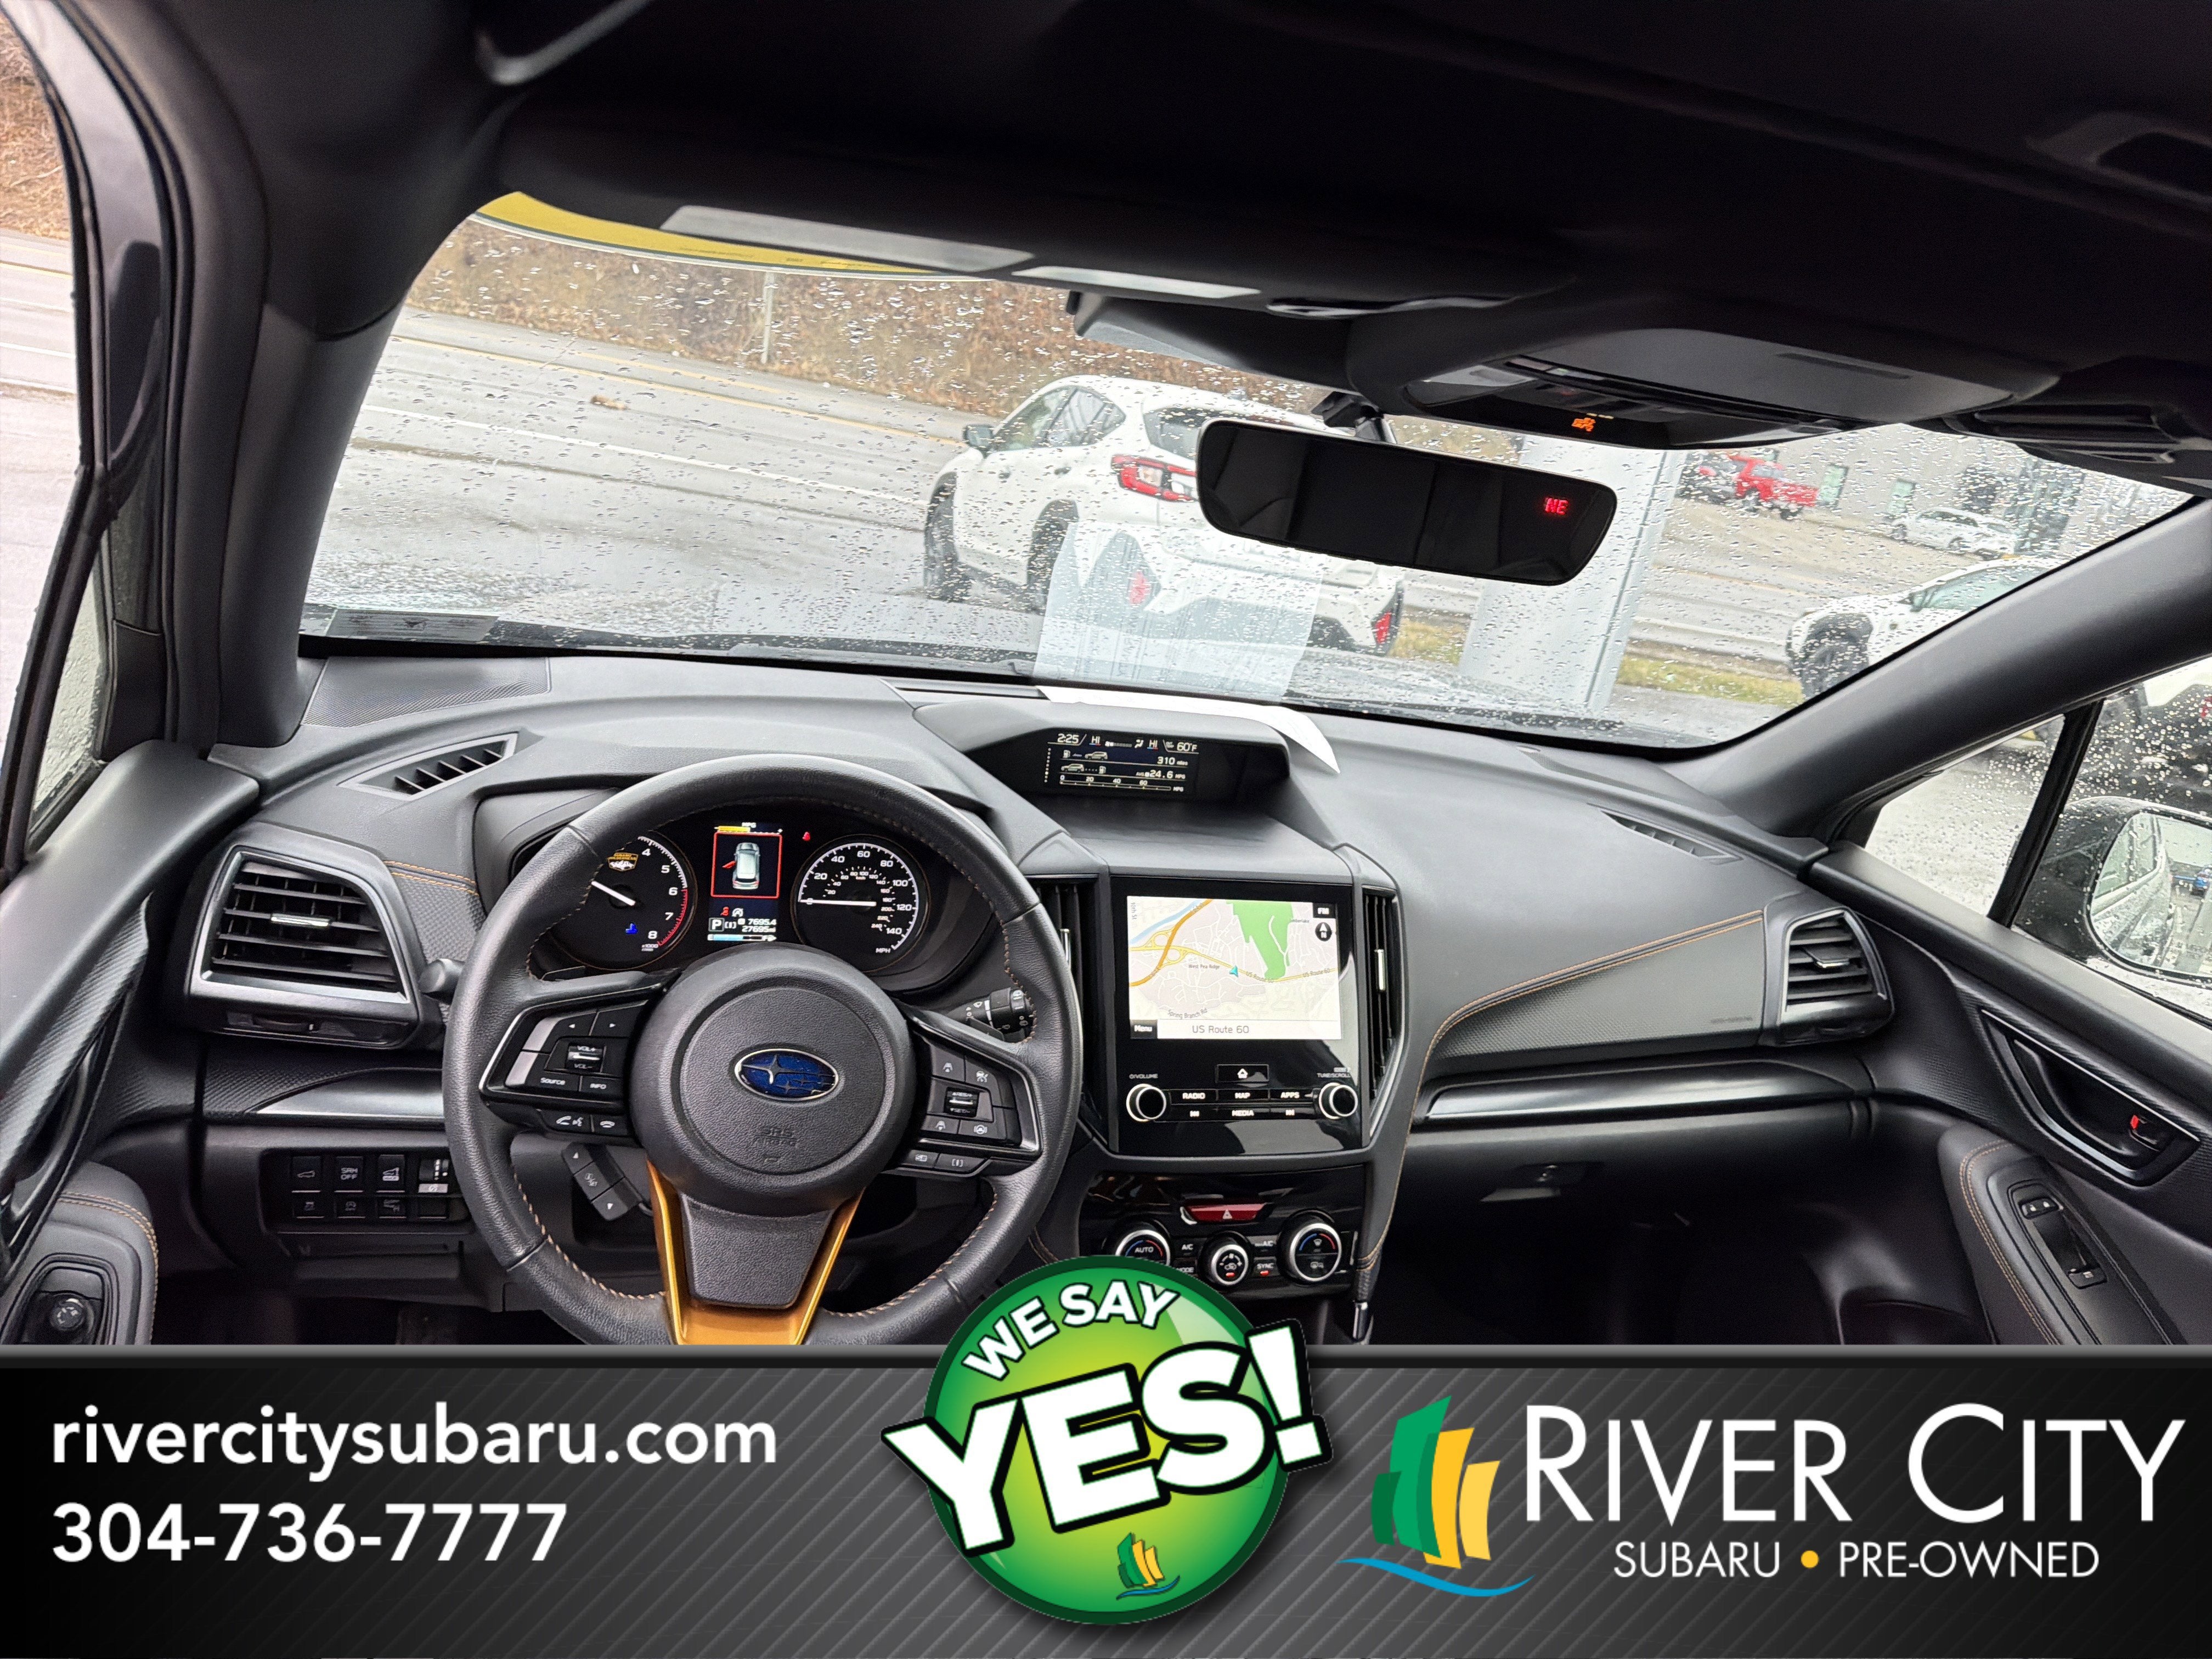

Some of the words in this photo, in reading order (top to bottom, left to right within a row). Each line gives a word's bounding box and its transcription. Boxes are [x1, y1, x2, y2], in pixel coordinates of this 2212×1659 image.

[1545, 498, 1568, 515] NE
[1058, 733, 1079, 744] 2:25
[1149, 740, 1158, 748] HI
[1157, 757, 1176, 765] 310
[1150, 770, 1173, 779] 24.6
[642, 848, 651, 856] 4
[661, 865, 670, 873] 5
[669, 887, 678, 895] 6
[664, 912, 674, 921] 7
[712, 919, 722, 930] P
[648, 930, 657, 939] 8
[1167, 1009, 1182, 1019] Spring
[1192, 1025, 1205, 1034] US
[1208, 1025, 1233, 1034] Route
[1236, 1025, 1250, 1034] 60
